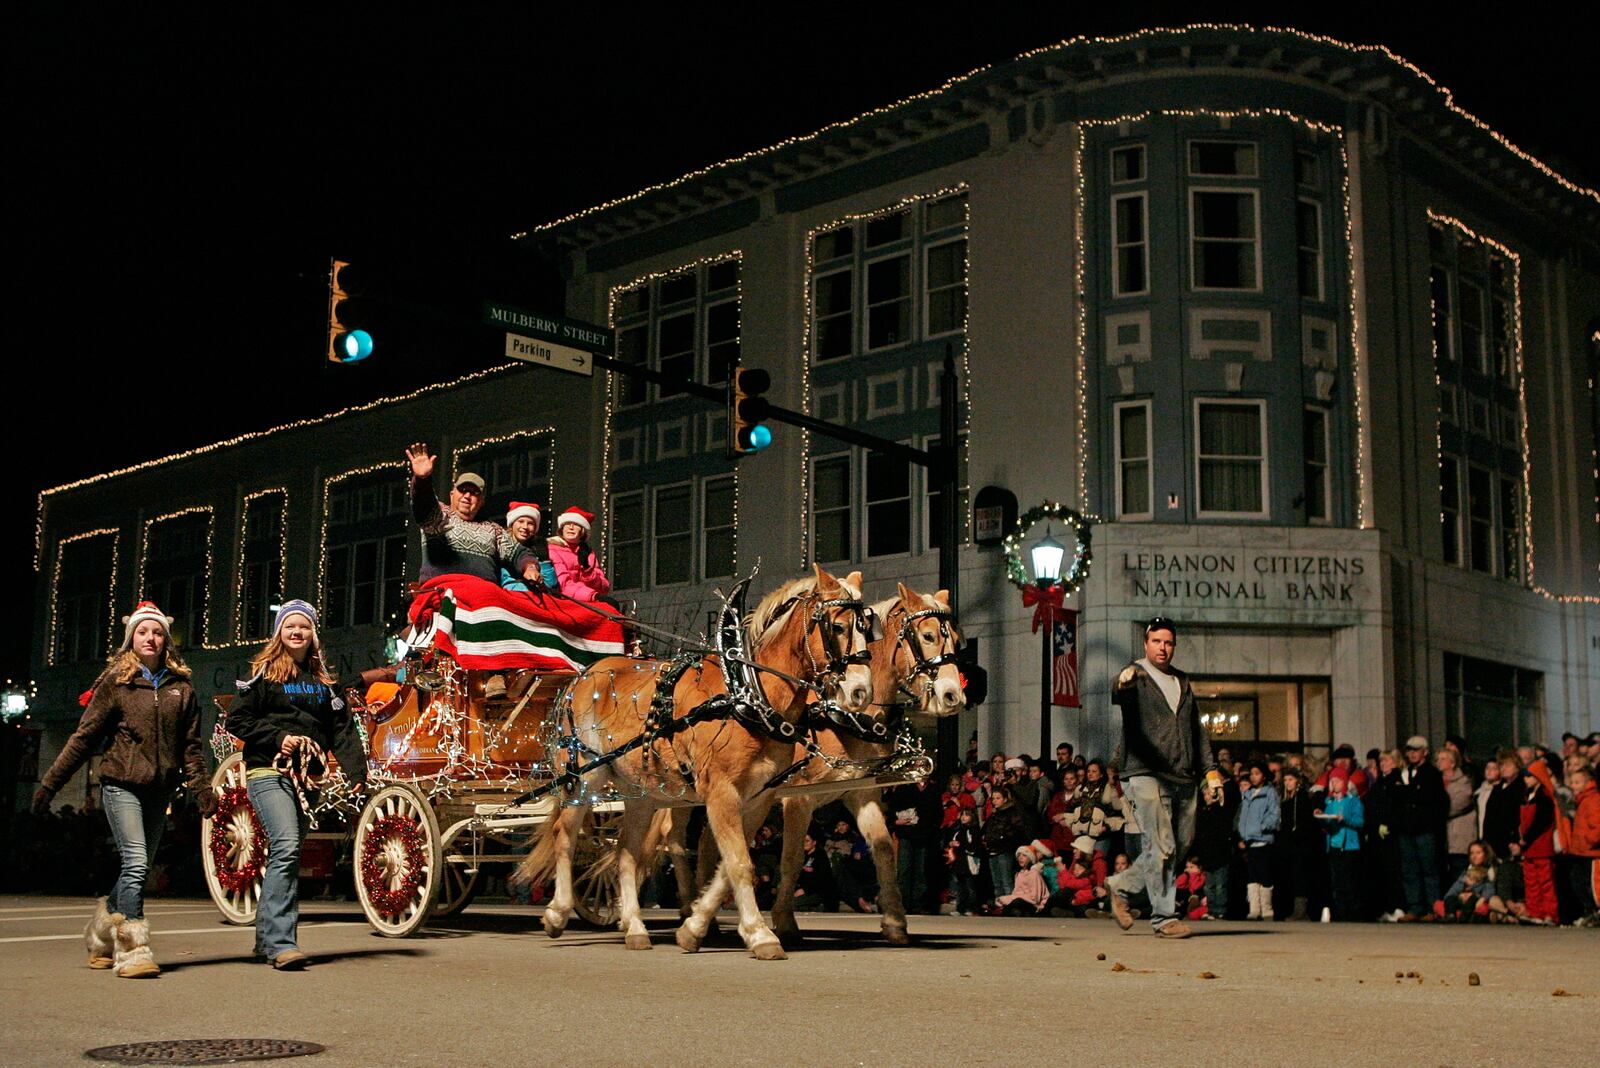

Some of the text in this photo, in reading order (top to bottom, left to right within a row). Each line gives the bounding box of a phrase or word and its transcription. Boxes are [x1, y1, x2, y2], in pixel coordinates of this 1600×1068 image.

[490, 307, 608, 347] MULBERRY STREET
[512, 338, 552, 361] Parking
[1123, 553, 1365, 576] LEBANON CITIZENS
[1134, 580, 1355, 601] NATIONAL BANK
